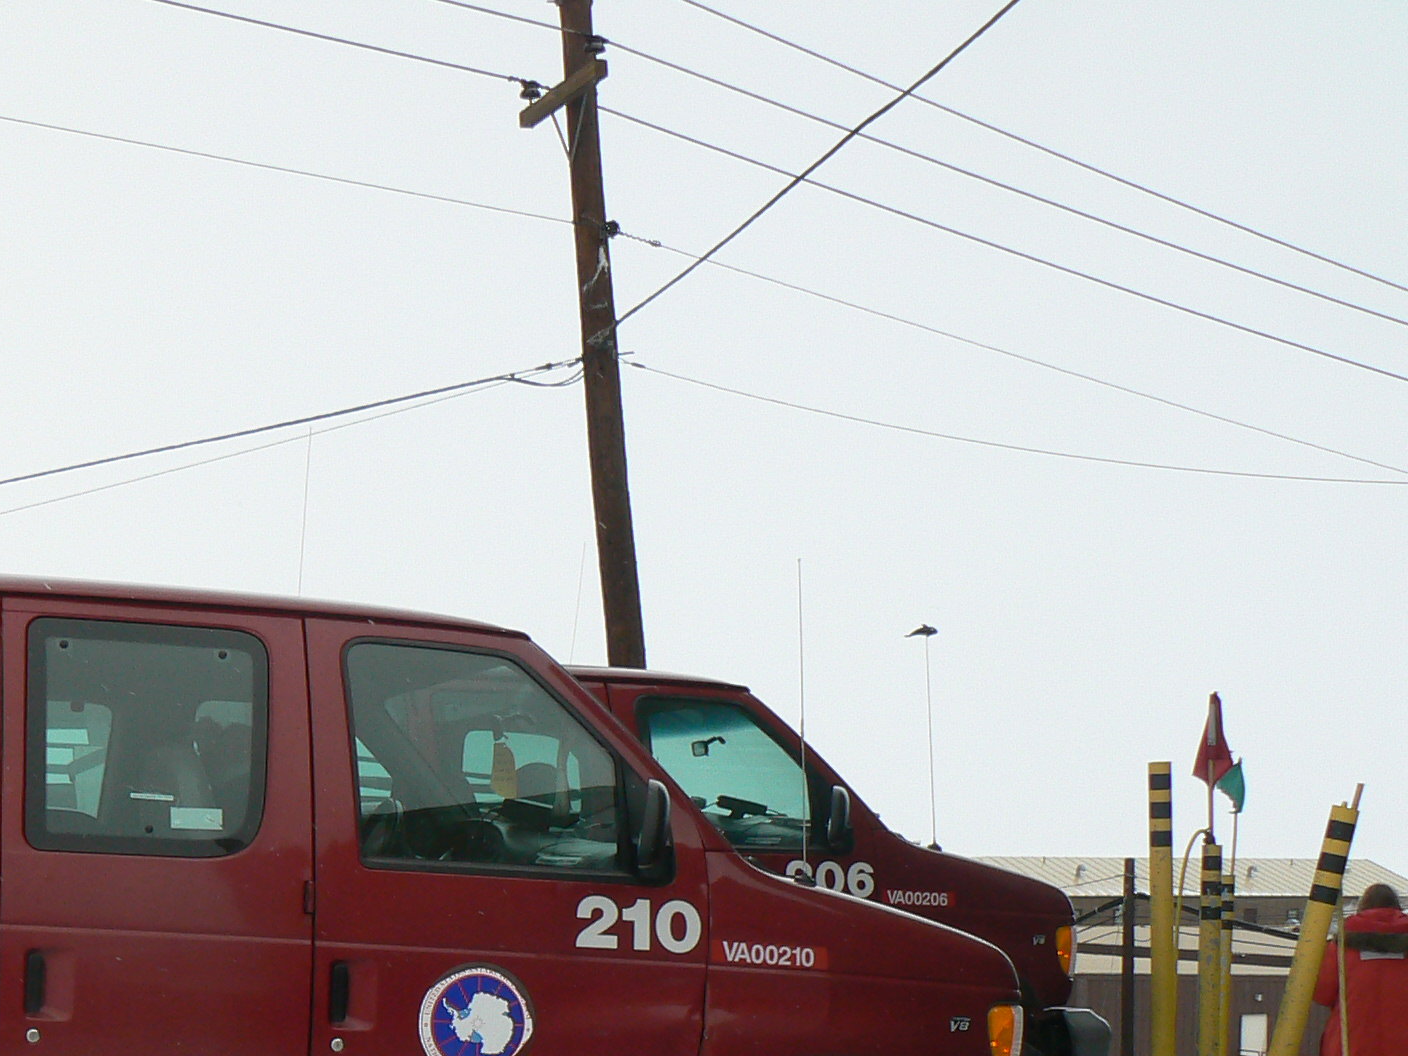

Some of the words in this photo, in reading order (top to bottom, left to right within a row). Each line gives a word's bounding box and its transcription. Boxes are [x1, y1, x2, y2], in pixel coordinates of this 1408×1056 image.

[887, 889, 948, 906] VA00206
[576, 895, 702, 954] 210
[723, 941, 815, 968] VA00210
[950, 1019, 970, 1032] V8
